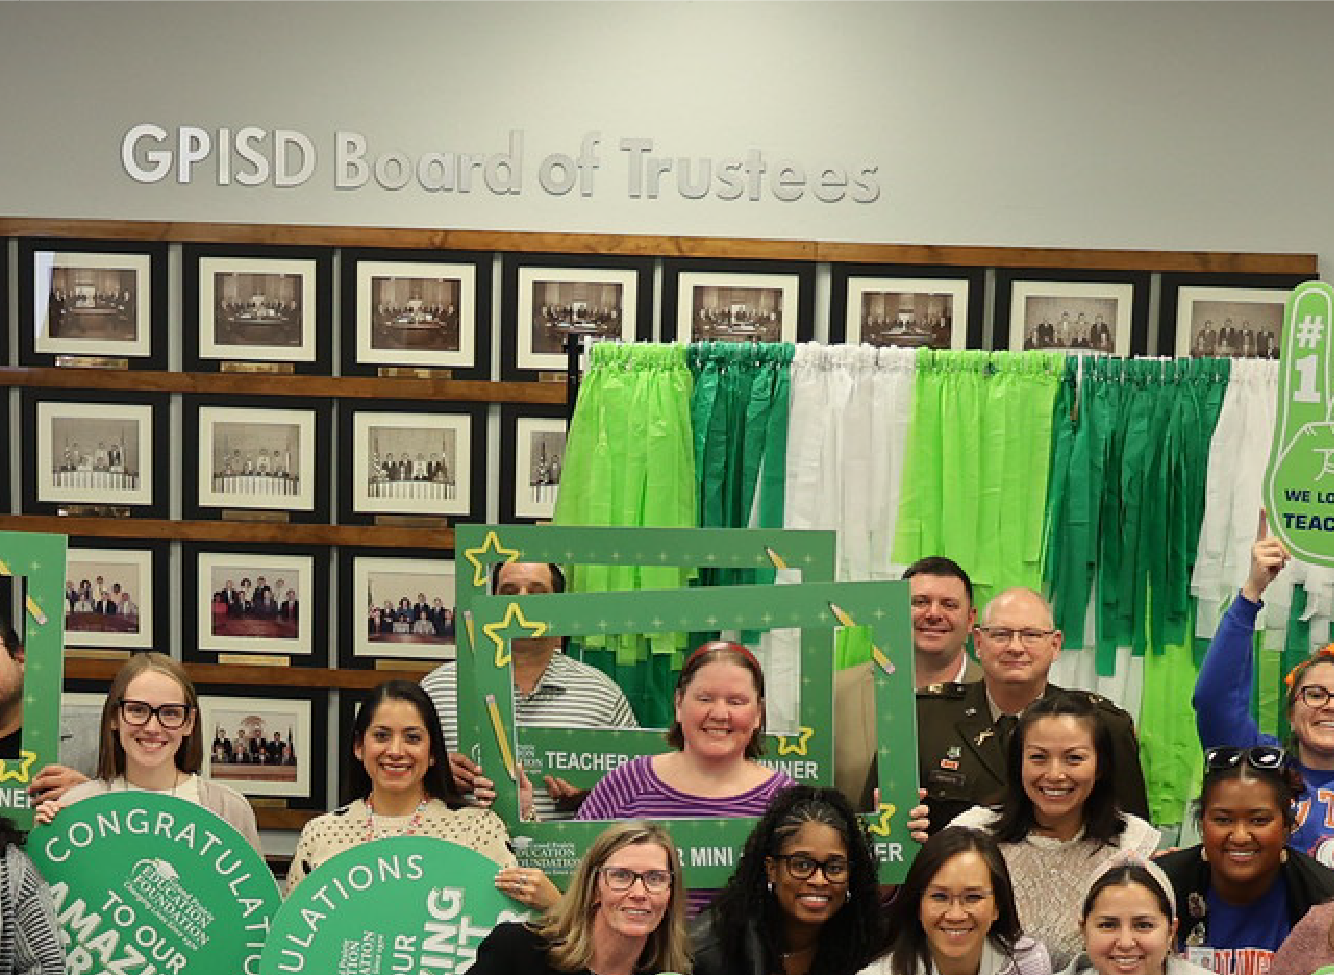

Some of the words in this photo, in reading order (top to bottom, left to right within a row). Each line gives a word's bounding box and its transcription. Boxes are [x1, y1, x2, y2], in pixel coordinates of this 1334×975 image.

[122, 122, 317, 188] GPISD
[334, 129, 527, 196] Board
[537, 133, 601, 197] of
[620, 137, 882, 204] Trustees
[1283, 489, 1311, 503] WE
[546, 750, 628, 772] TEACHER
[690, 845, 732, 867] MINI
[101, 890, 135, 926] TO
